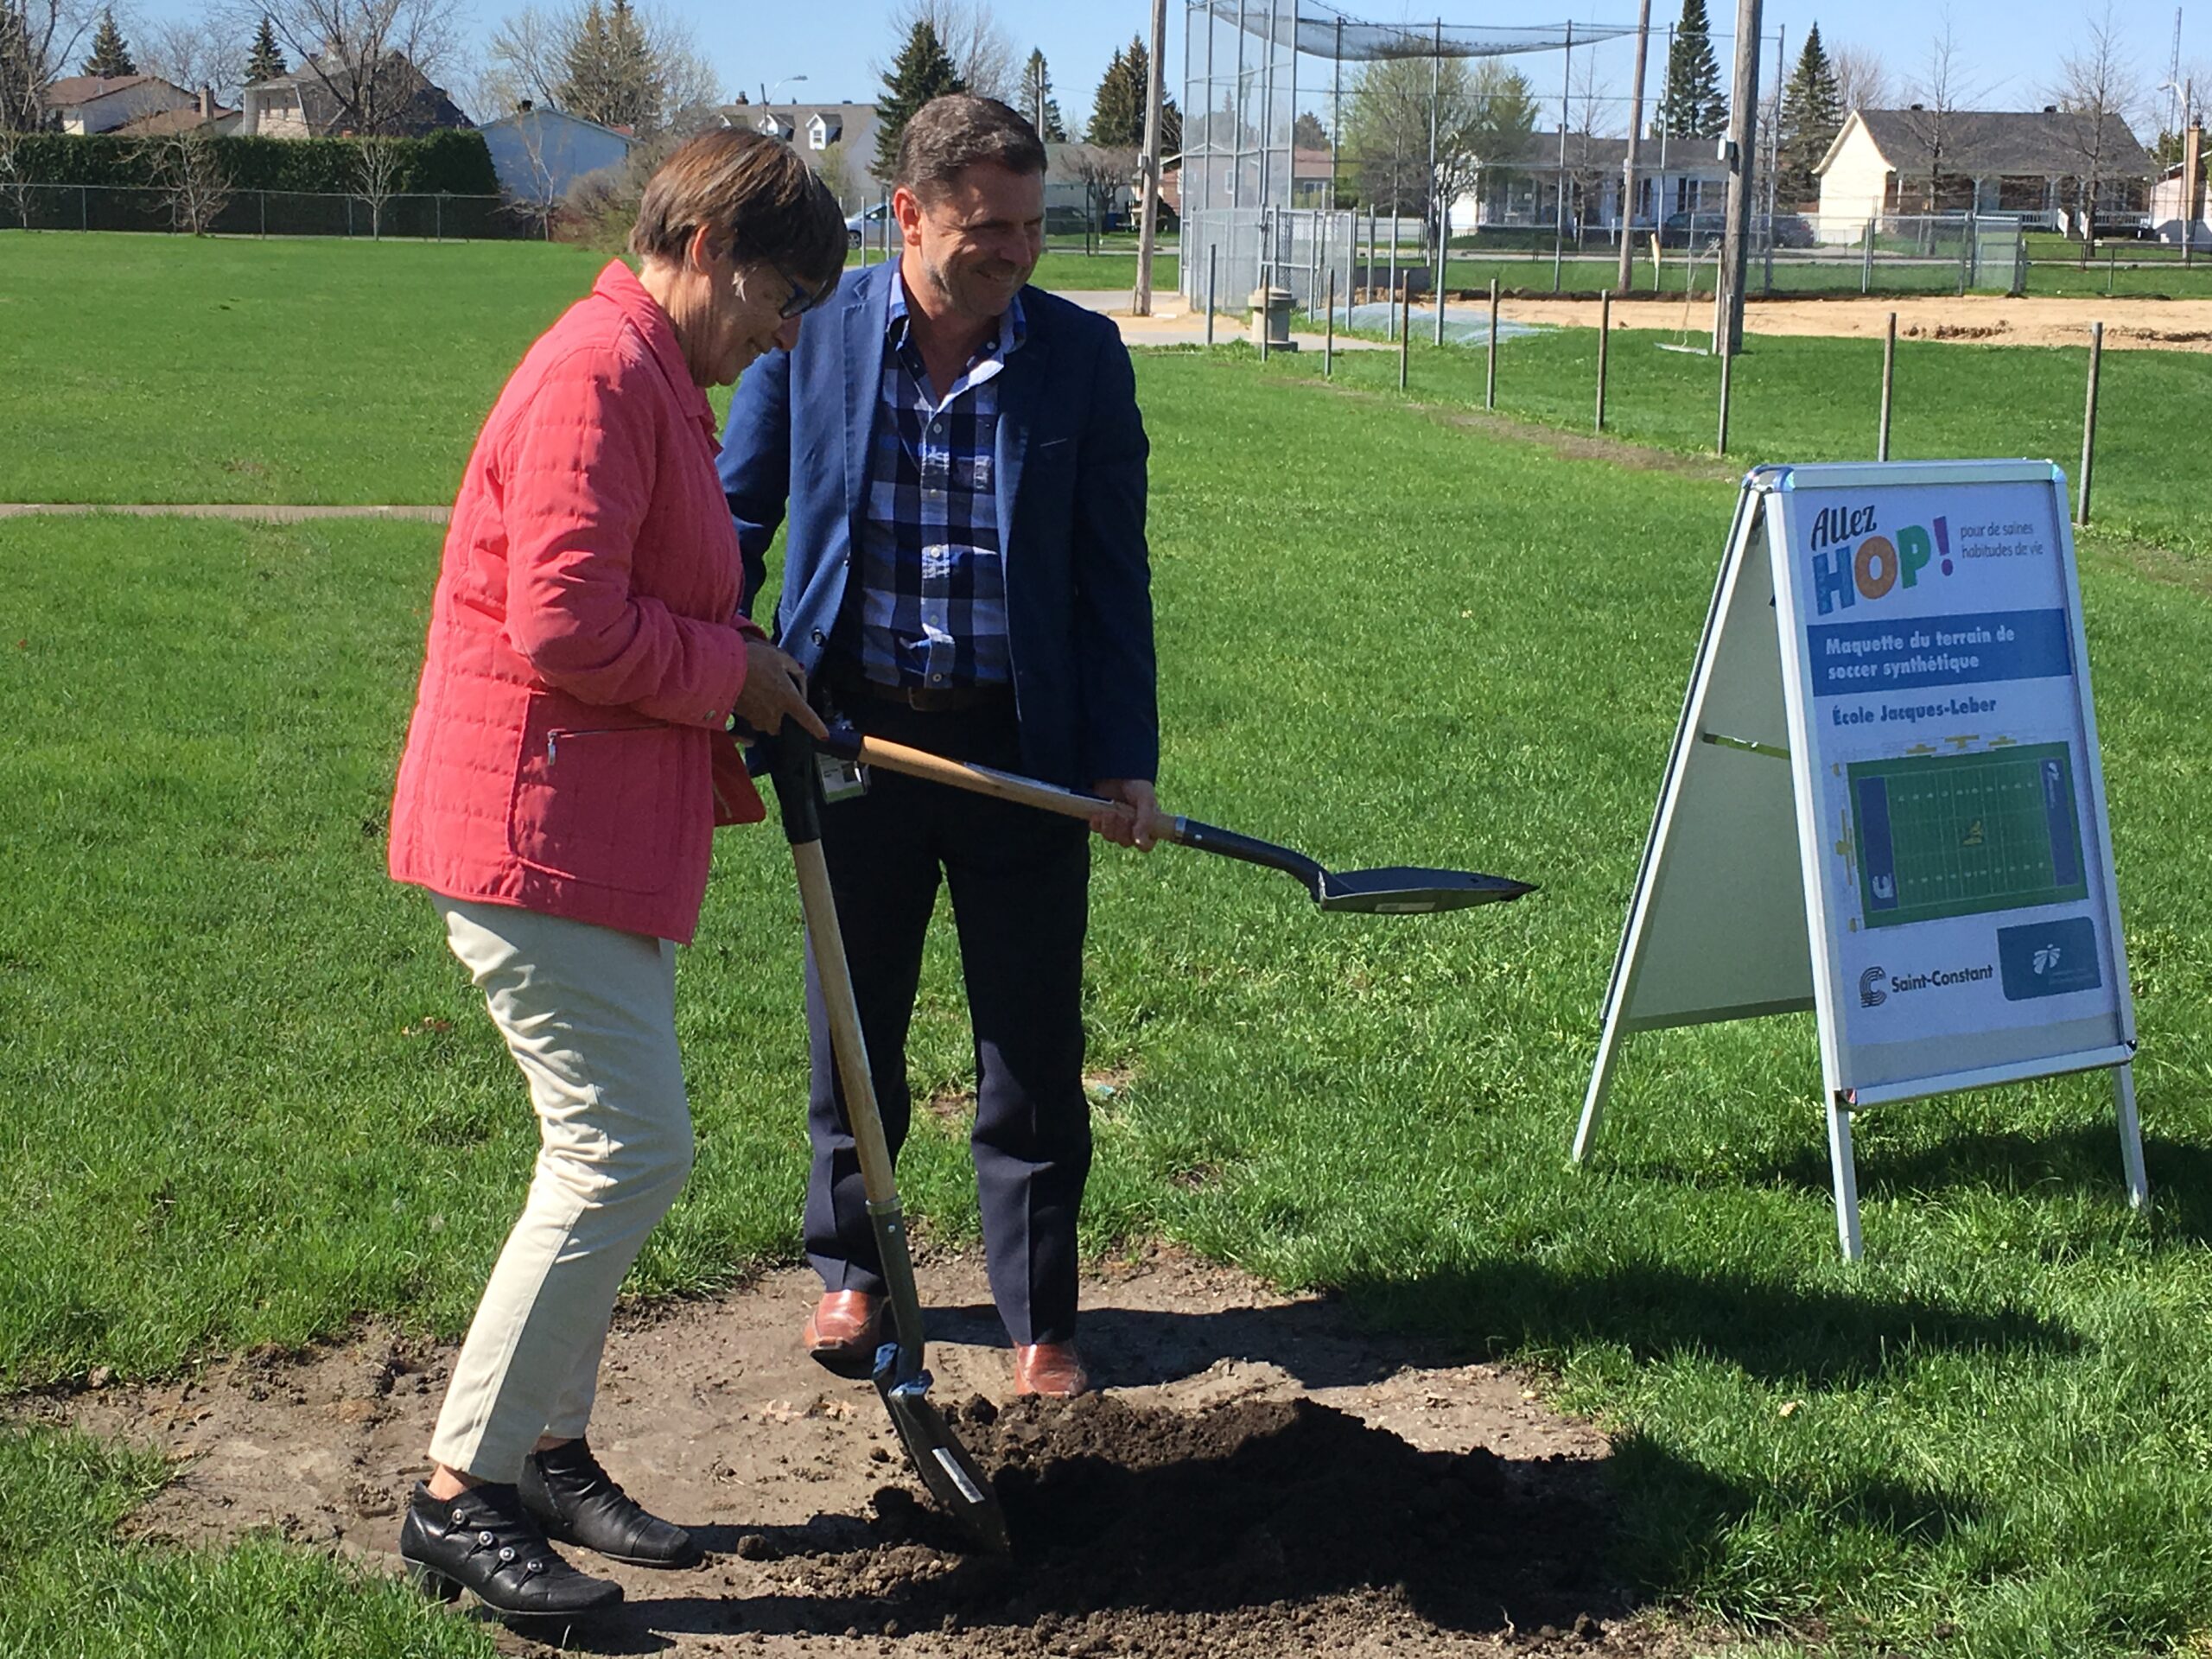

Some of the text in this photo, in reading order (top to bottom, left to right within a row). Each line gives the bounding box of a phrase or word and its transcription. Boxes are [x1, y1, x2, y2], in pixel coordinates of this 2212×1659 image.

[1811, 505, 1877, 550] Allez
[1960, 522, 2033, 541] pour de saines
[1961, 541, 2044, 558] habitudes de vie
[1812, 516, 1954, 616] HOP!
[1826, 626, 2015, 658] Maquette du terrain de
[1828, 653, 1980, 680] soccer synthétique
[1833, 696, 1996, 725] École Jacques-Leber
[1891, 965, 1993, 993] Saint-Constant
